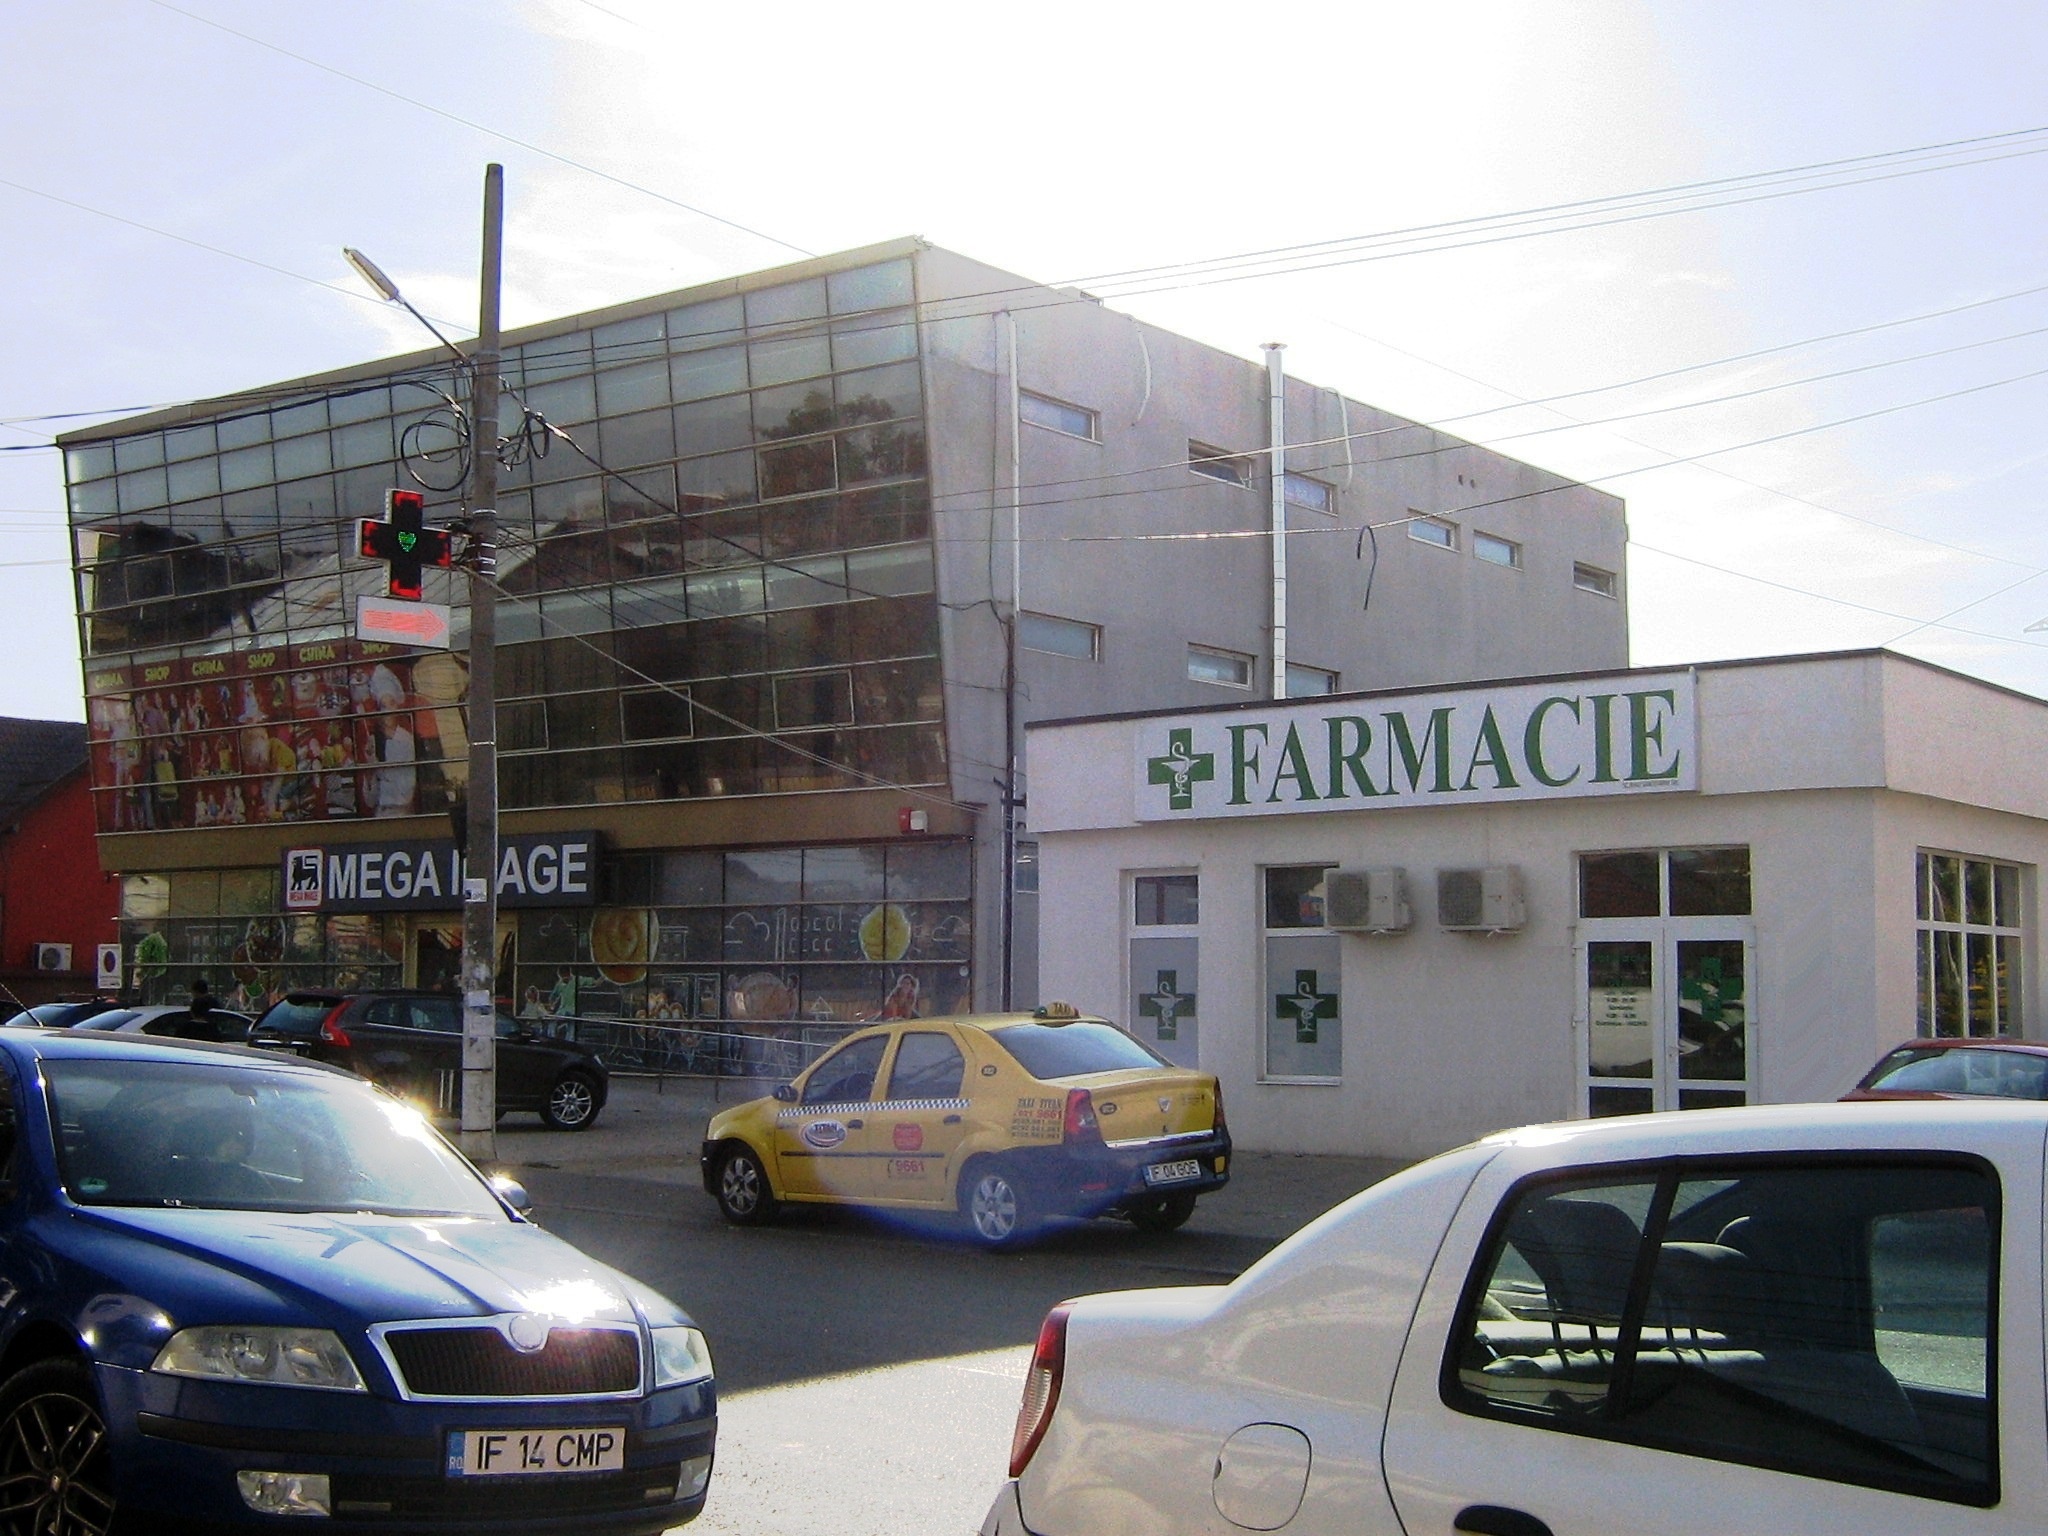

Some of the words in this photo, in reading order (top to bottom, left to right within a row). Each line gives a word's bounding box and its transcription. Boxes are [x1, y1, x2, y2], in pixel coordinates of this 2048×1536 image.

[145, 666, 170, 682] SHOP
[192, 660, 225, 676] CHINA
[248, 652, 276, 669] SHOP
[299, 645, 336, 662] CHINA
[1225, 689, 1681, 805] FARMACIE
[328, 851, 442, 900] MEGA
[451, 843, 588, 896] IAGE
[814, 1122, 840, 1134] TITAN
[449, 1456, 464, 1470] RO
[477, 1435, 507, 1470] IF
[519, 1435, 546, 1469] 14
[556, 1433, 614, 1467] CMP
